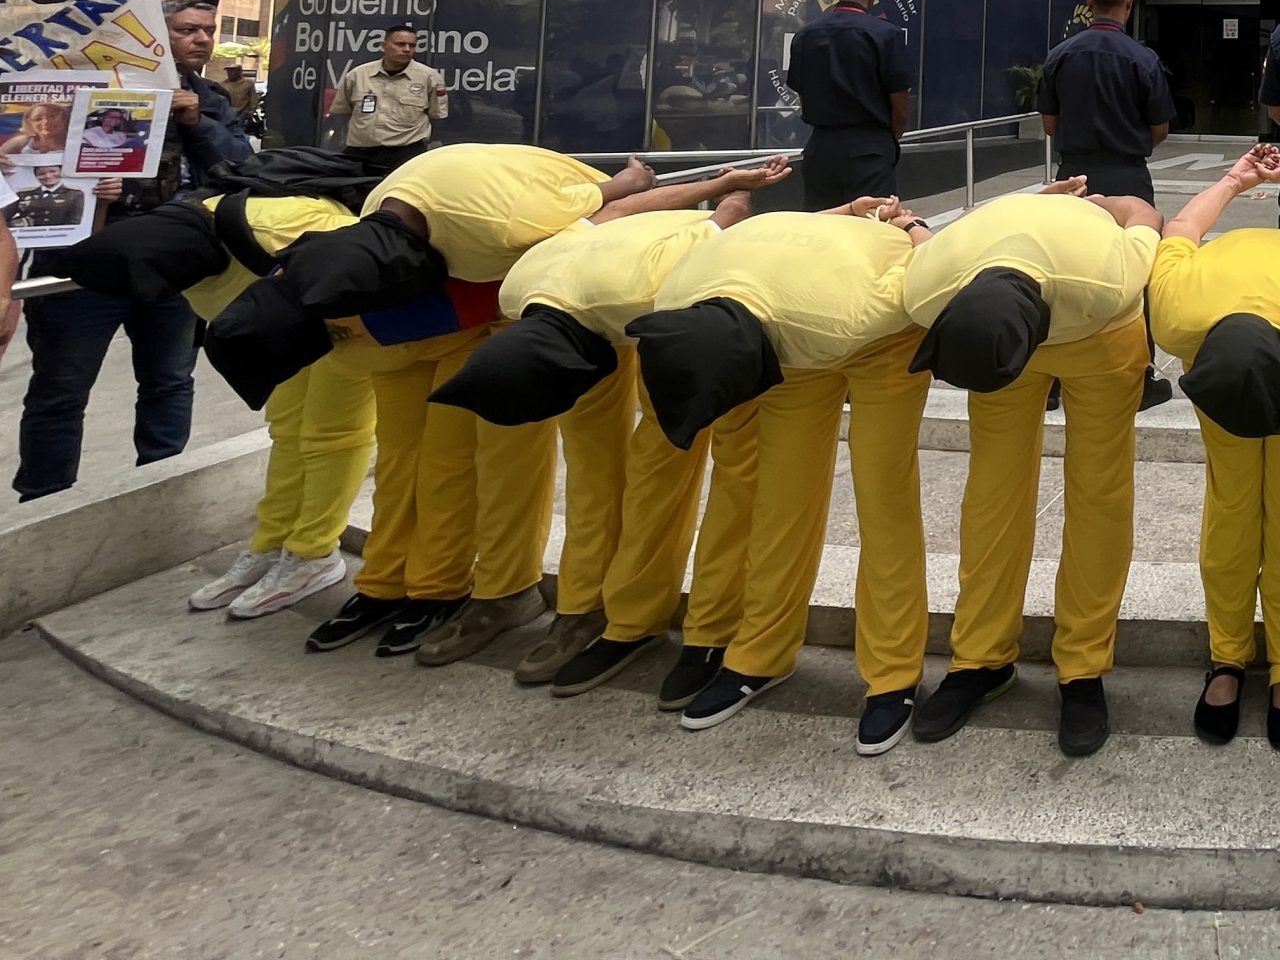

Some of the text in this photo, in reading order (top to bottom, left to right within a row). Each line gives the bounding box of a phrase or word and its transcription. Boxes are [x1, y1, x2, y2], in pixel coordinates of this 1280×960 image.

[295, 21, 489, 54] Bolivaano
[292, 58, 518, 92] de Vuela
[769, 69, 790, 102] Hacia
